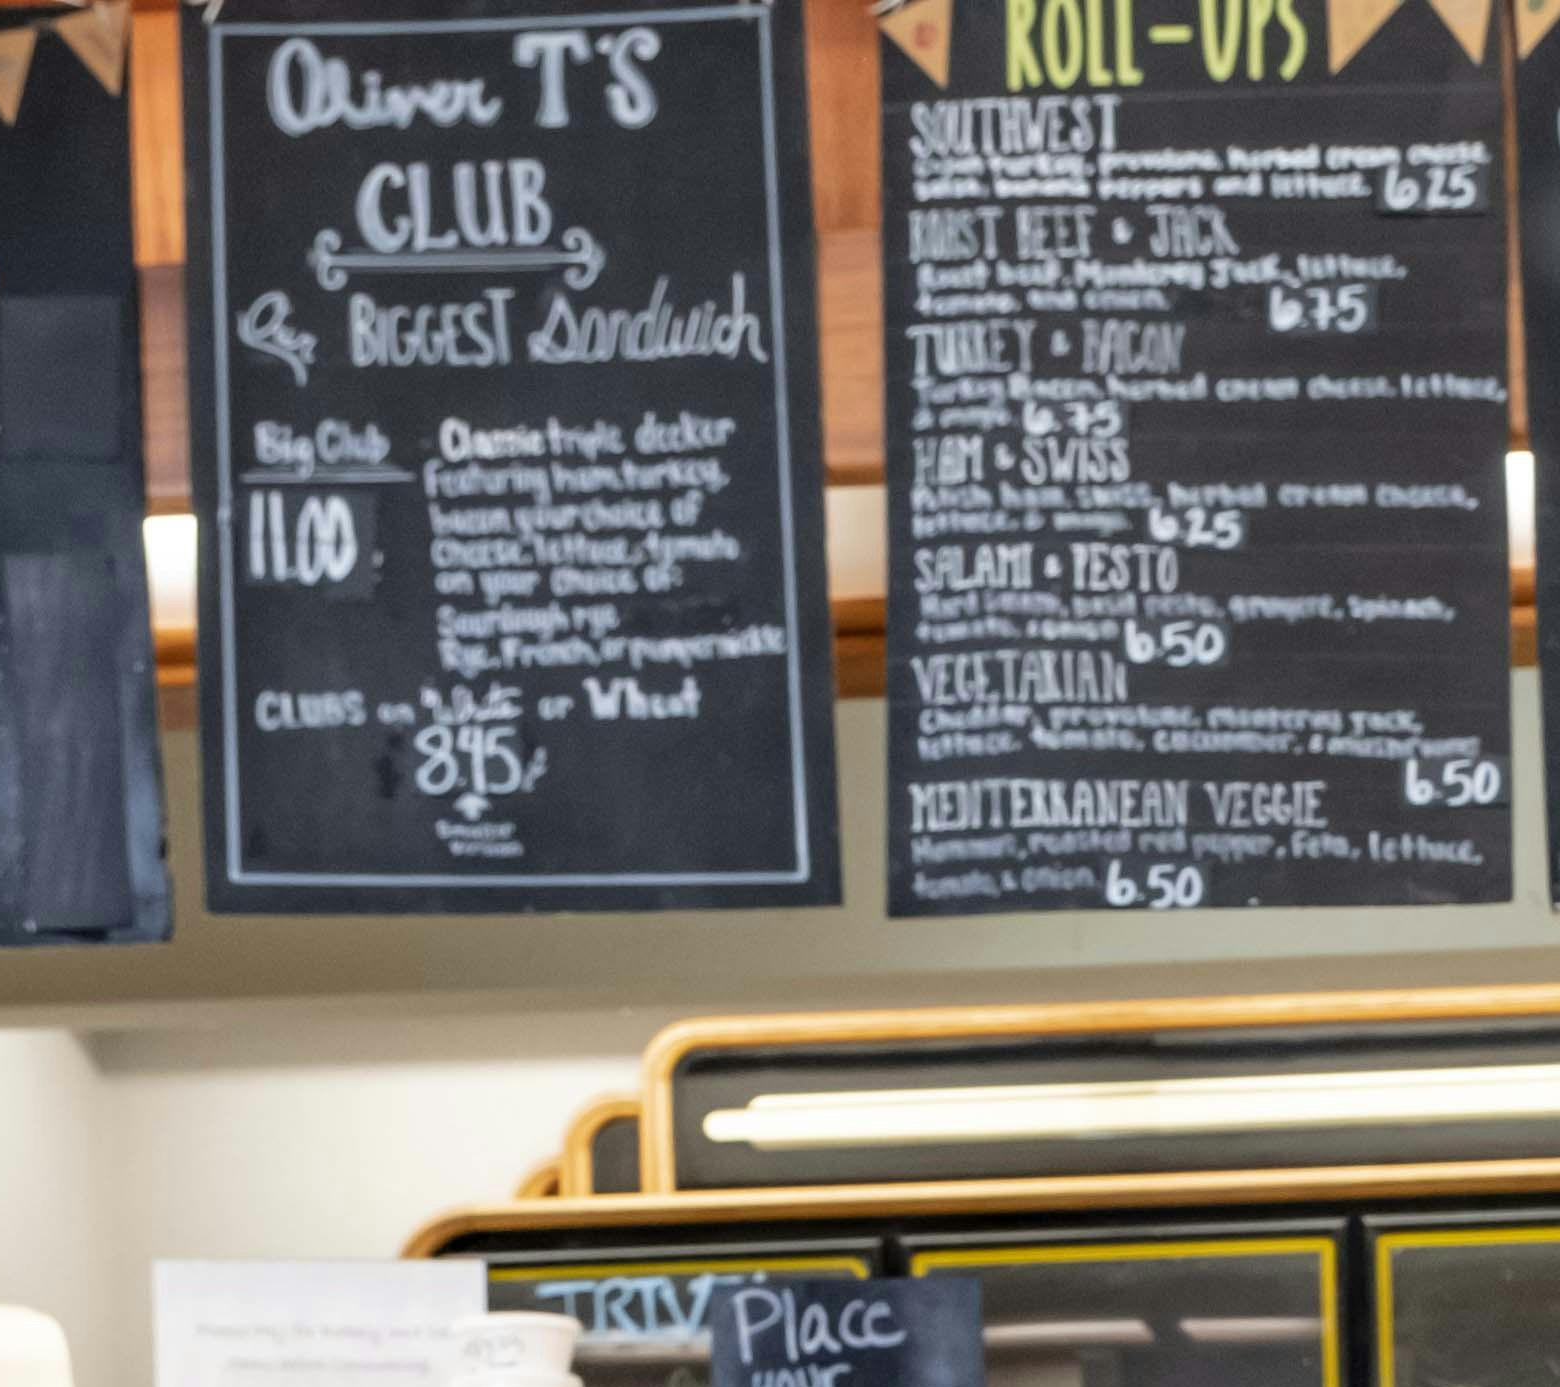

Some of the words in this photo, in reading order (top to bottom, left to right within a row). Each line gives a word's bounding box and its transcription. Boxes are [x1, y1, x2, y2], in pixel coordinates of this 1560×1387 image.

[266, 38, 502, 137] Oliver
[909, 95, 1122, 157] SOUTHWEST
[356, 158, 554, 253] CLUB
[1145, 203, 1240, 258] JACK
[348, 286, 516, 367] BIGGEST
[905, 319, 1037, 379] TURKEY
[1081, 321, 1186, 375] BACON
[253, 421, 316, 479] Big
[314, 418, 391, 465] Club
[634, 410, 736, 455] decker
[912, 436, 984, 485] HAM
[1020, 438, 1131, 487] SWISS
[248, 490, 359, 586] 11.00
[914, 543, 1034, 593] SALAMI
[1072, 543, 1180, 594] PESTO
[1125, 620, 1227, 665] 6.50
[581, 676, 703, 720] Wheat
[911, 649, 1128, 704] VEGETARIAN
[909, 779, 1188, 834] MEDITERRANEAN
[1204, 780, 1329, 828] VEGGIE
[1403, 758, 1503, 805] 6.50
[1104, 860, 1204, 909] 6.50
[535, 1273, 747, 1337] TRIV
[732, 1288, 907, 1364] Place
